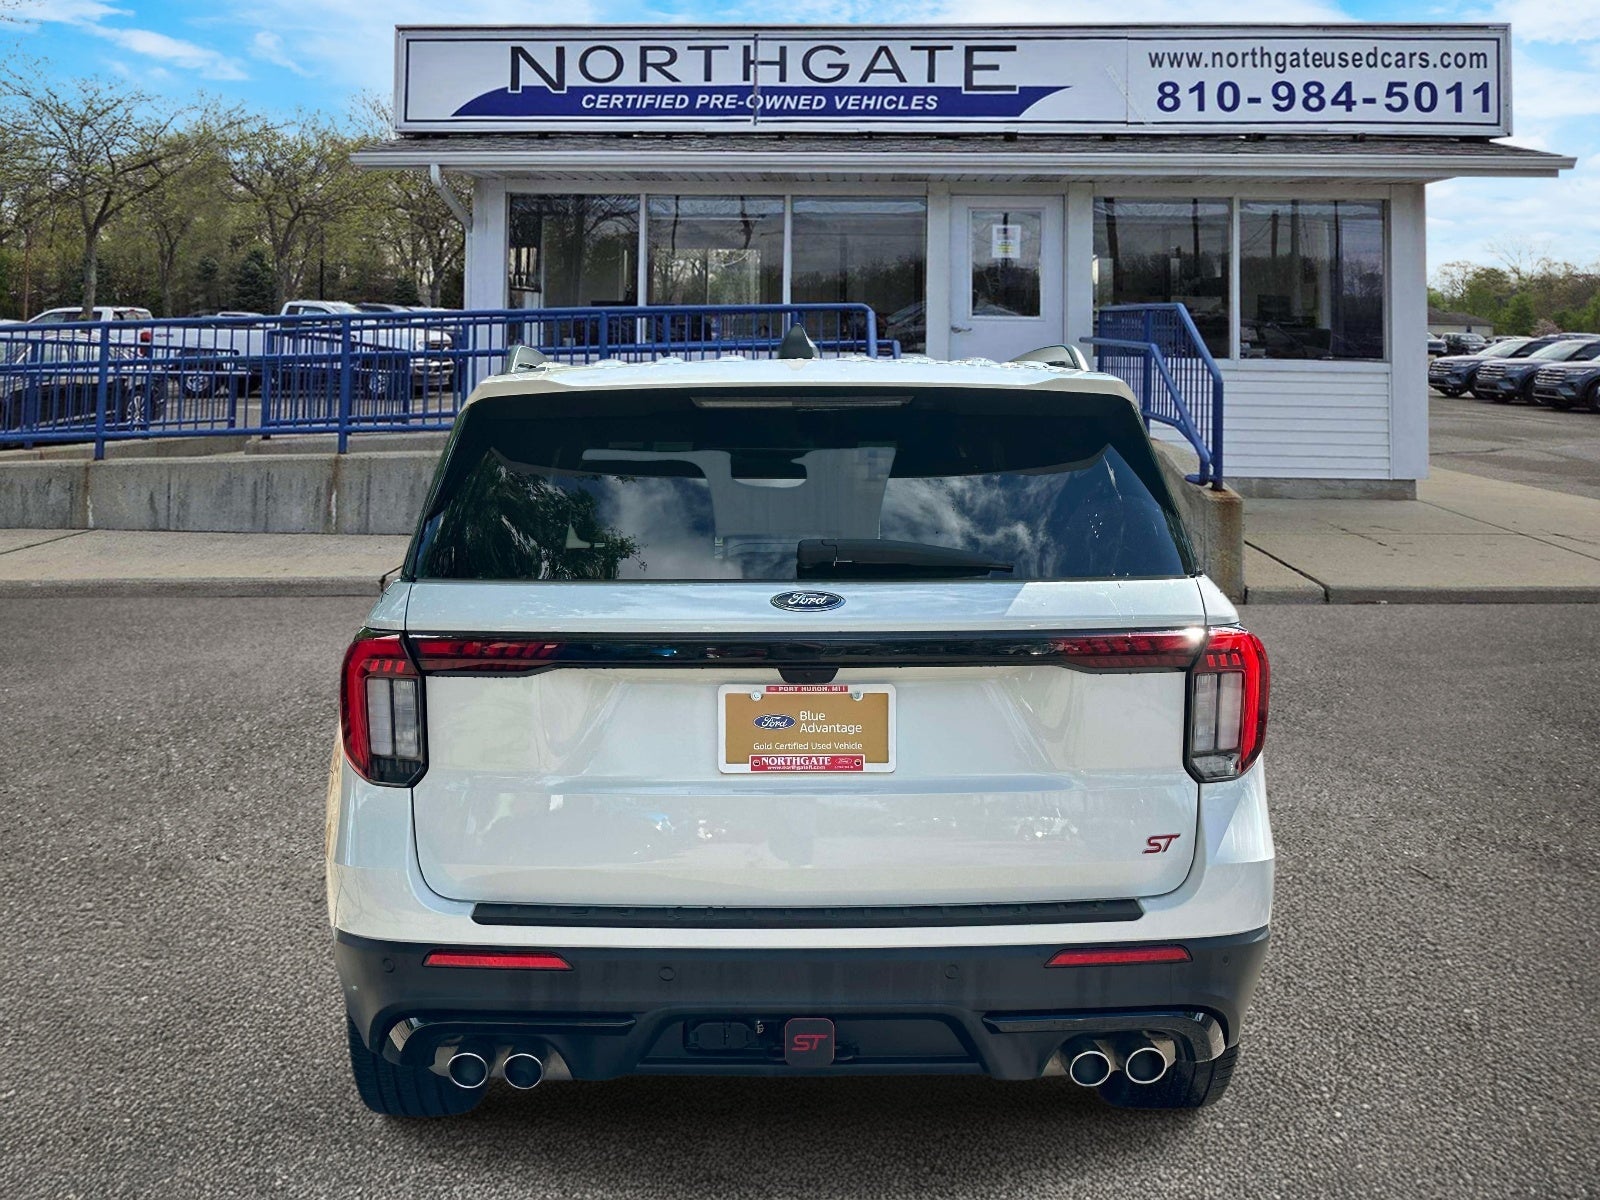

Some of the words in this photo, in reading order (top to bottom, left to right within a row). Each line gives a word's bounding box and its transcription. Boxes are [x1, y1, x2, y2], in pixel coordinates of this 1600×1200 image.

[1148, 46, 1488, 74] www.northgateusedcars.com
[508, 44, 1018, 95] NORTHGATE
[581, 94, 689, 109] CERTIFIED
[695, 94, 827, 110] PRE-OWNED
[834, 95, 939, 110] VEHICLES
[1156, 80, 1490, 113] 810-984-5011
[761, 715, 788, 728] Ford
[799, 710, 826, 721] Blue
[799, 722, 863, 735] Advantage
[753, 742, 772, 750] Gold
[774, 742, 809, 750] Certified
[811, 742, 832, 750] Used
[834, 742, 863, 750] Vehicle
[761, 756, 832, 766] NORTHGATE
[1142, 833, 1181, 854] ST
[791, 1034, 828, 1051] ST
